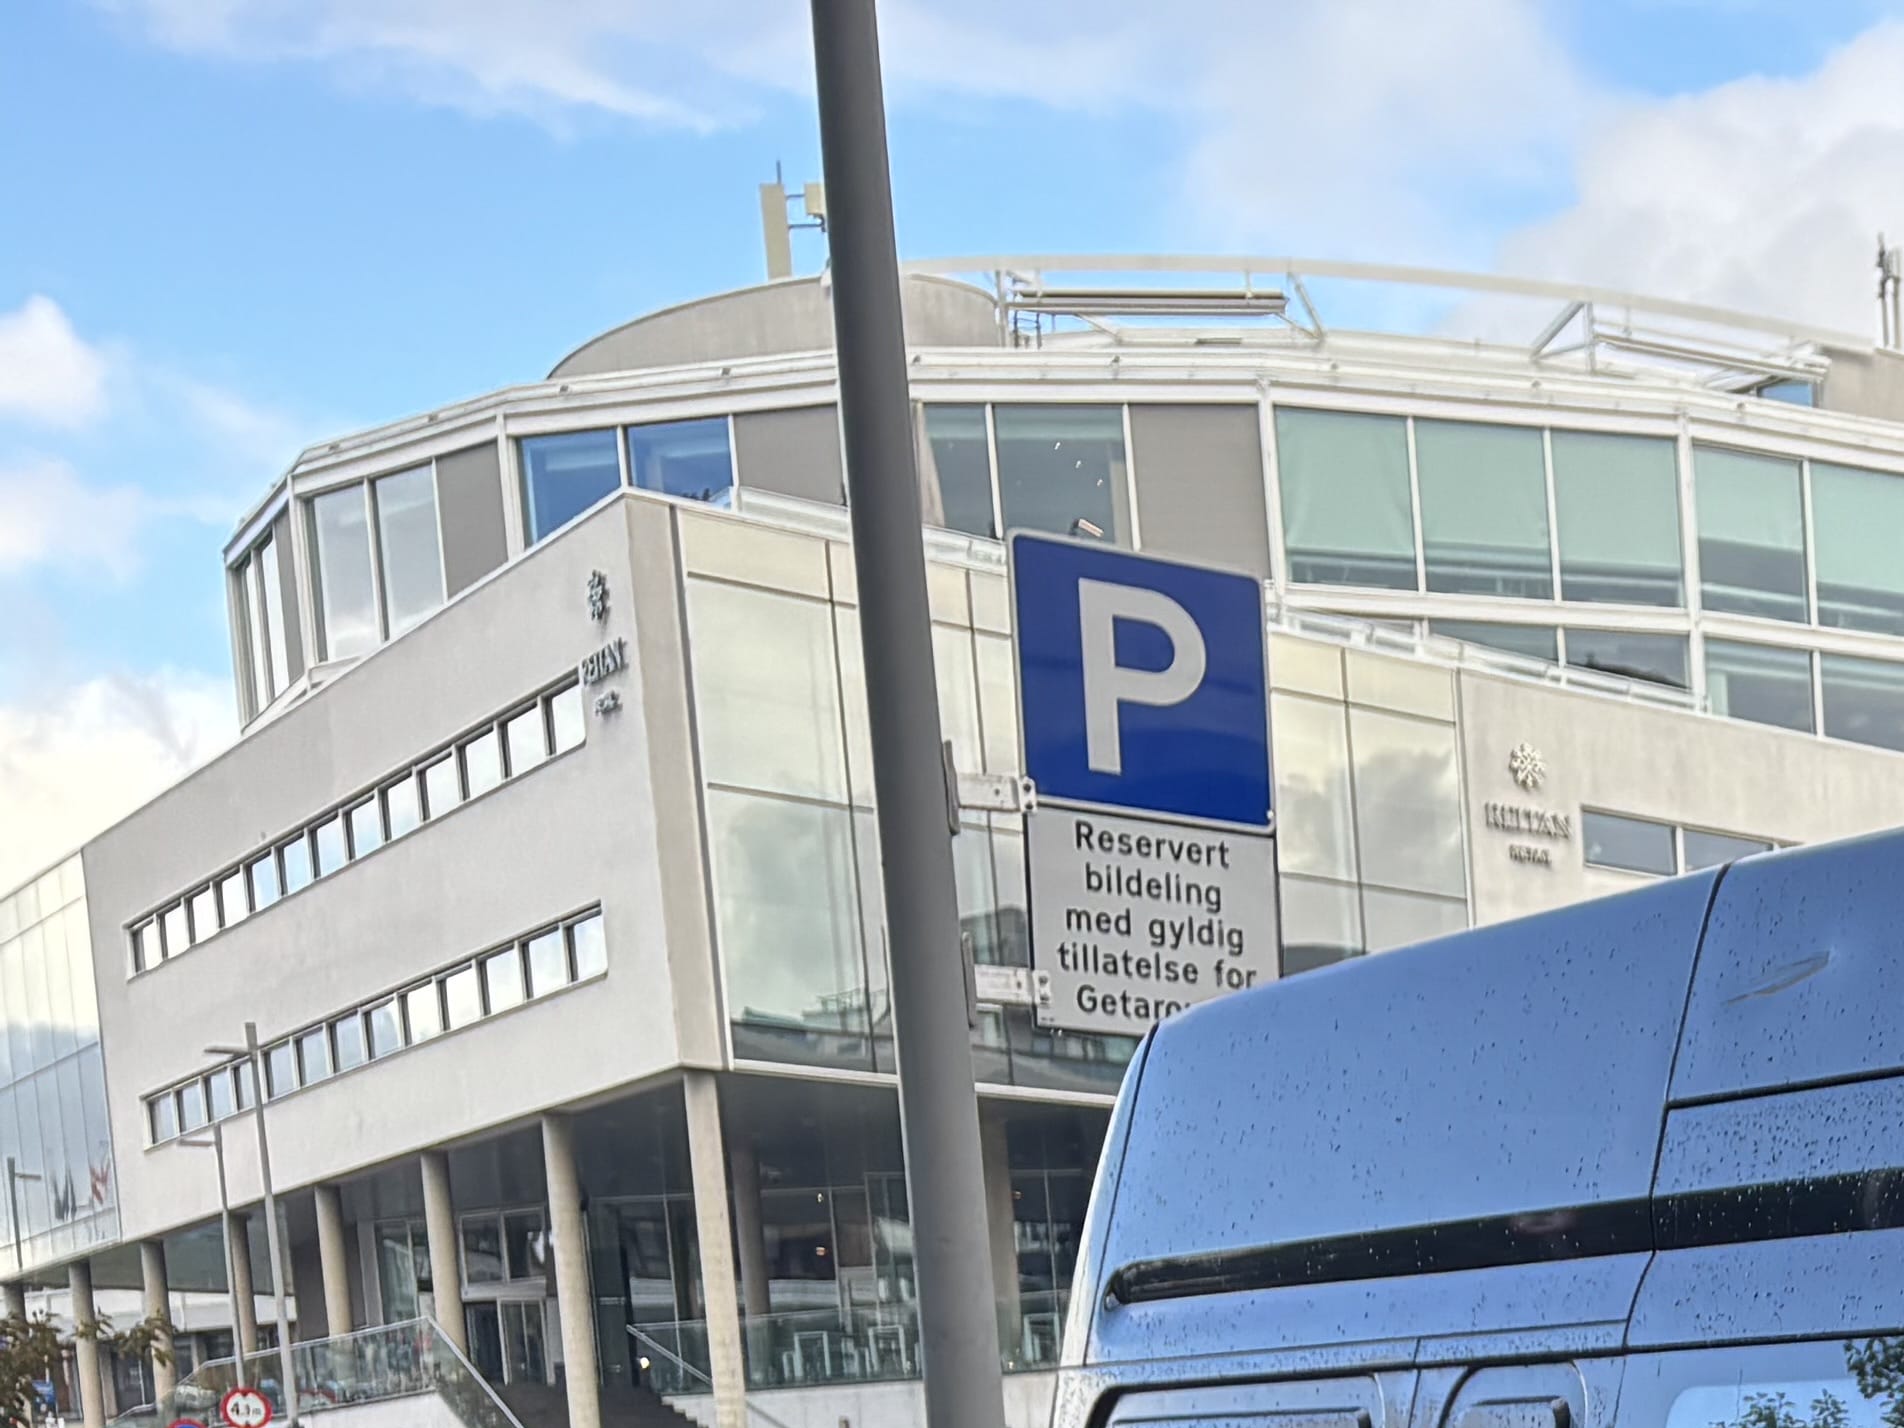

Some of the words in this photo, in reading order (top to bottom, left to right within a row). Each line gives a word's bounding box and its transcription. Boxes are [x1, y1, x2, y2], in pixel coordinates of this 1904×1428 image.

[1077, 577, 1207, 776] P
[1074, 820, 1230, 869] Reservert
[1085, 863, 1222, 912] bildeling
[1066, 904, 1132, 937] med
[1148, 916, 1244, 955] gyldig
[1056, 942, 1199, 985] tillatelse
[1214, 957, 1257, 989] for
[1076, 985, 1191, 1019] Getaro
